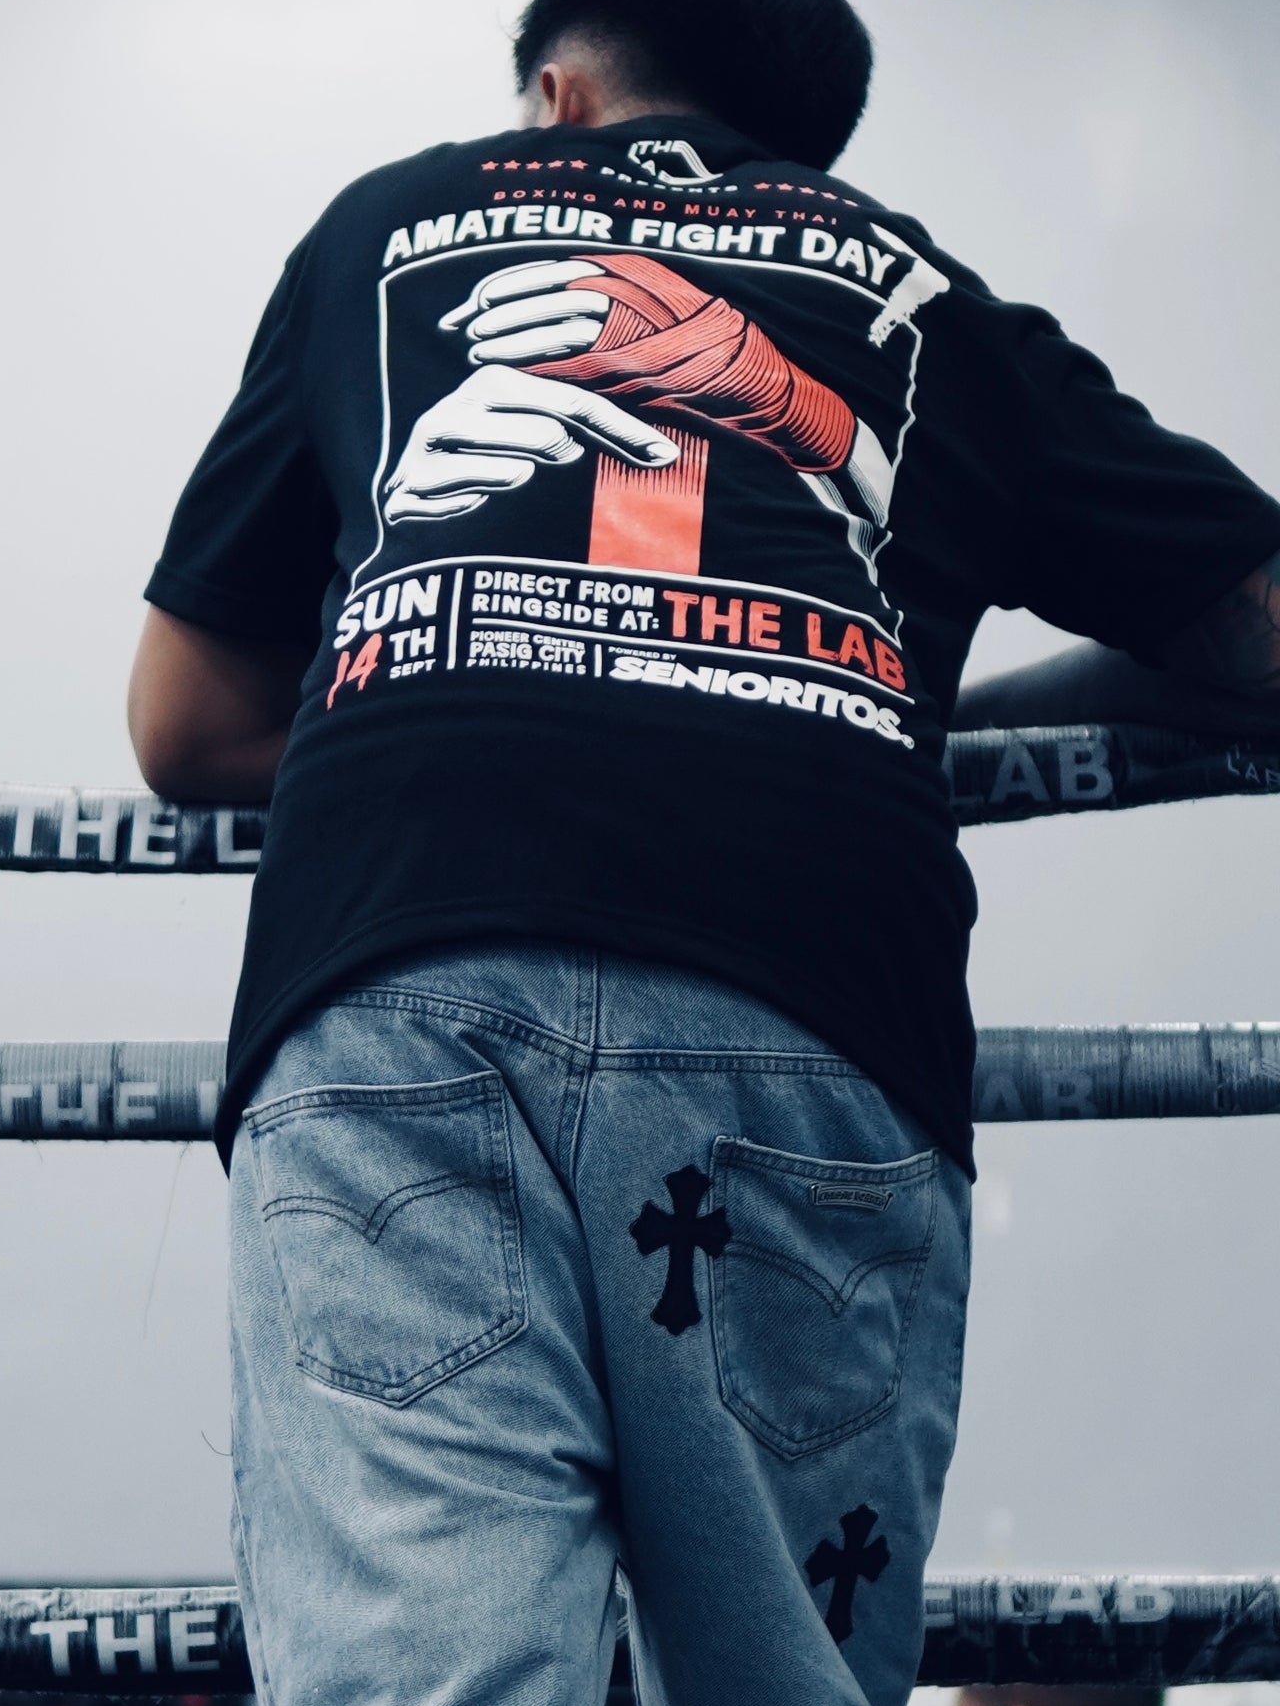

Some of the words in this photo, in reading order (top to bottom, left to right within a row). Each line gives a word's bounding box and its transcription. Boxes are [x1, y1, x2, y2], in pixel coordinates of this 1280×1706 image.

[636, 140, 685, 155] THE
[493, 189, 597, 202] BOXING
[614, 197, 667, 212] AND
[685, 204, 756, 218] MUAY
[776, 209, 837, 225] THAI
[382, 205, 613, 267] AMATEUR
[631, 217, 786, 257] FIGHT
[799, 227, 897, 286] DAY
[474, 570, 571, 599] DIRECT
[578, 580, 655, 608] FROM
[334, 574, 442, 649] SUN
[471, 593, 608, 626] RINGSIDE
[620, 606, 659, 631] AT:
[470, 630, 530, 643] PIONEER
[532, 634, 585, 650] CENTER
[470, 641, 532, 660] PASIG
[539, 645, 585, 664] CITY
[608, 646, 660, 660] POWERED
[662, 652, 677, 661] BY
[663, 590, 781, 650] THE
[807, 611, 907, 691] LAB
[327, 633, 383, 711] 14
[389, 625, 437, 662] TH
[389, 658, 437, 680] SEPT
[466, 658, 587, 675] PHILIPPINES
[0, 793, 176, 865] THE
[978, 1071, 1097, 1119] AB
[997, 1576, 1174, 1625] LAB
[30, 1609, 220, 1676] THE
